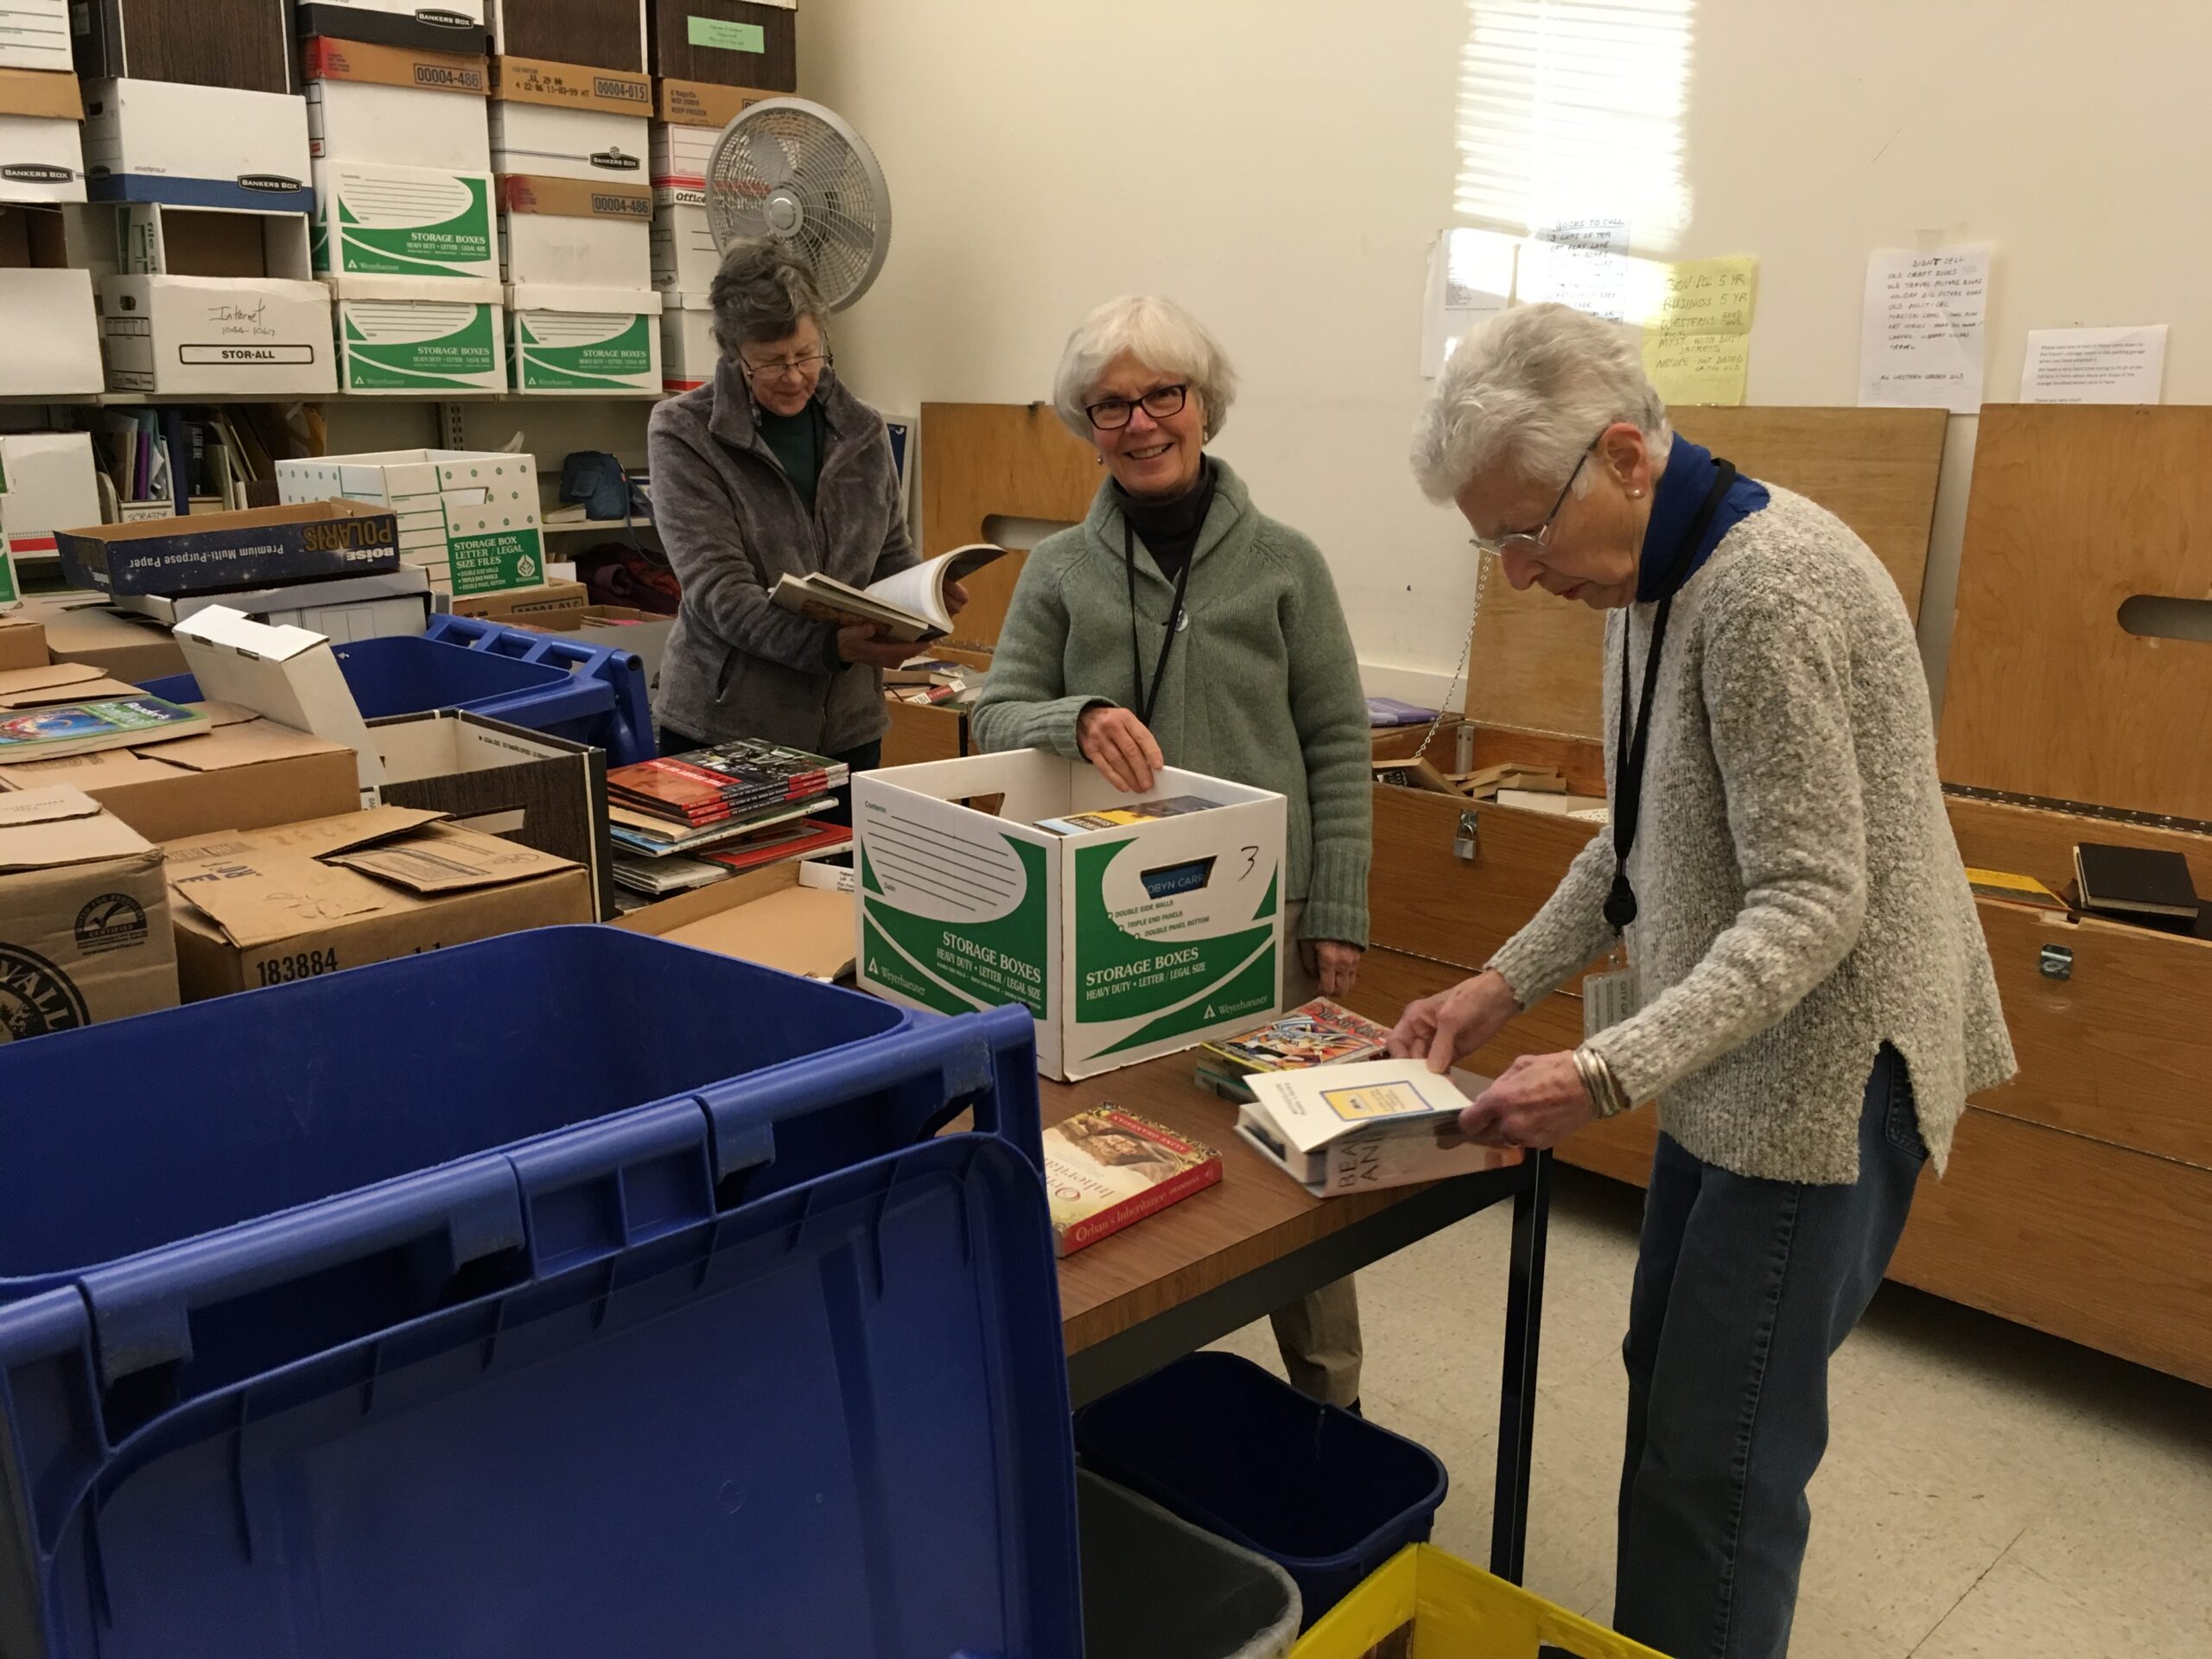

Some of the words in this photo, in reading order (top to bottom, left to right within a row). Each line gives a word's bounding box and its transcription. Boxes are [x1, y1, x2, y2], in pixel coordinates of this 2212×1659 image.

[418, 12, 453, 23] BANKERS
[454, 17, 470, 26] BOX
[416, 67, 479, 87] 00004-486
[598, 80, 645, 99] 00004-015
[594, 156, 622, 165] BANKERS
[4, 168, 48, 178] BANKERS
[242, 179, 280, 188] BANKERS
[594, 196, 648, 213] 00004-486
[410, 232, 454, 243] STORAGE
[455, 235, 486, 245] BOXES
[208, 297, 265, 326] Internet
[1663, 297, 1713, 311] BUSINESS
[582, 349, 619, 358] STORAGE
[128, 510, 168, 522] SCRATCH
[304, 518, 393, 552] POLARIS
[454, 537, 497, 550] STORAGE
[498, 536, 518, 546] BOX
[164, 549, 237, 565] Multi-Purpose
[239, 543, 283, 557] Premium
[454, 549, 489, 560] LETTER
[497, 544, 524, 556] LEGAL
[129, 556, 162, 569] Paper
[455, 559, 475, 569] SIZE
[478, 556, 502, 567] FILES
[1238, 845, 1259, 882] 3
[1147, 880, 1175, 895] OBYN
[1178, 874, 1205, 888] CARR
[1115, 907, 1139, 918] DOUBLE
[1140, 903, 1154, 912] SIDE
[1155, 899, 1174, 910] WALLS
[1127, 918, 1147, 929] TRIPLE
[1147, 916, 1160, 925] END
[1161, 910, 1183, 922] PANELS
[1144, 926, 1167, 938] DOUBLE
[1168, 922, 1186, 932] PANEL
[1187, 916, 1210, 927] BOTTOM
[89, 925, 133, 938] CERTIFIED
[943, 931, 997, 966] STORAGE
[1000, 952, 1041, 983] BOXES
[1085, 958, 1152, 987] STORAGE
[1154, 946, 1199, 971] BOXES
[256, 946, 339, 989] 183884
[937, 947, 955, 965] HEAVY
[956, 954, 973, 972] DUTY
[979, 964, 1002, 984] LETTER
[1007, 976, 1027, 995] LEGAL
[1027, 984, 1041, 1001] SIZE
[880, 966, 926, 997] Weyerhaeuser
[1086, 987, 1111, 1001] HEAVY
[1111, 981, 1131, 995] DUTY
[1138, 973, 1165, 988] LETTER
[1169, 967, 1191, 981] LEGAL
[1192, 961, 1207, 973] SIZE
[1218, 994, 1268, 1015] Weyerhaeuser
[1075, 1216, 1116, 1243] Orhan's
[1116, 1192, 1166, 1224] Inheritance
